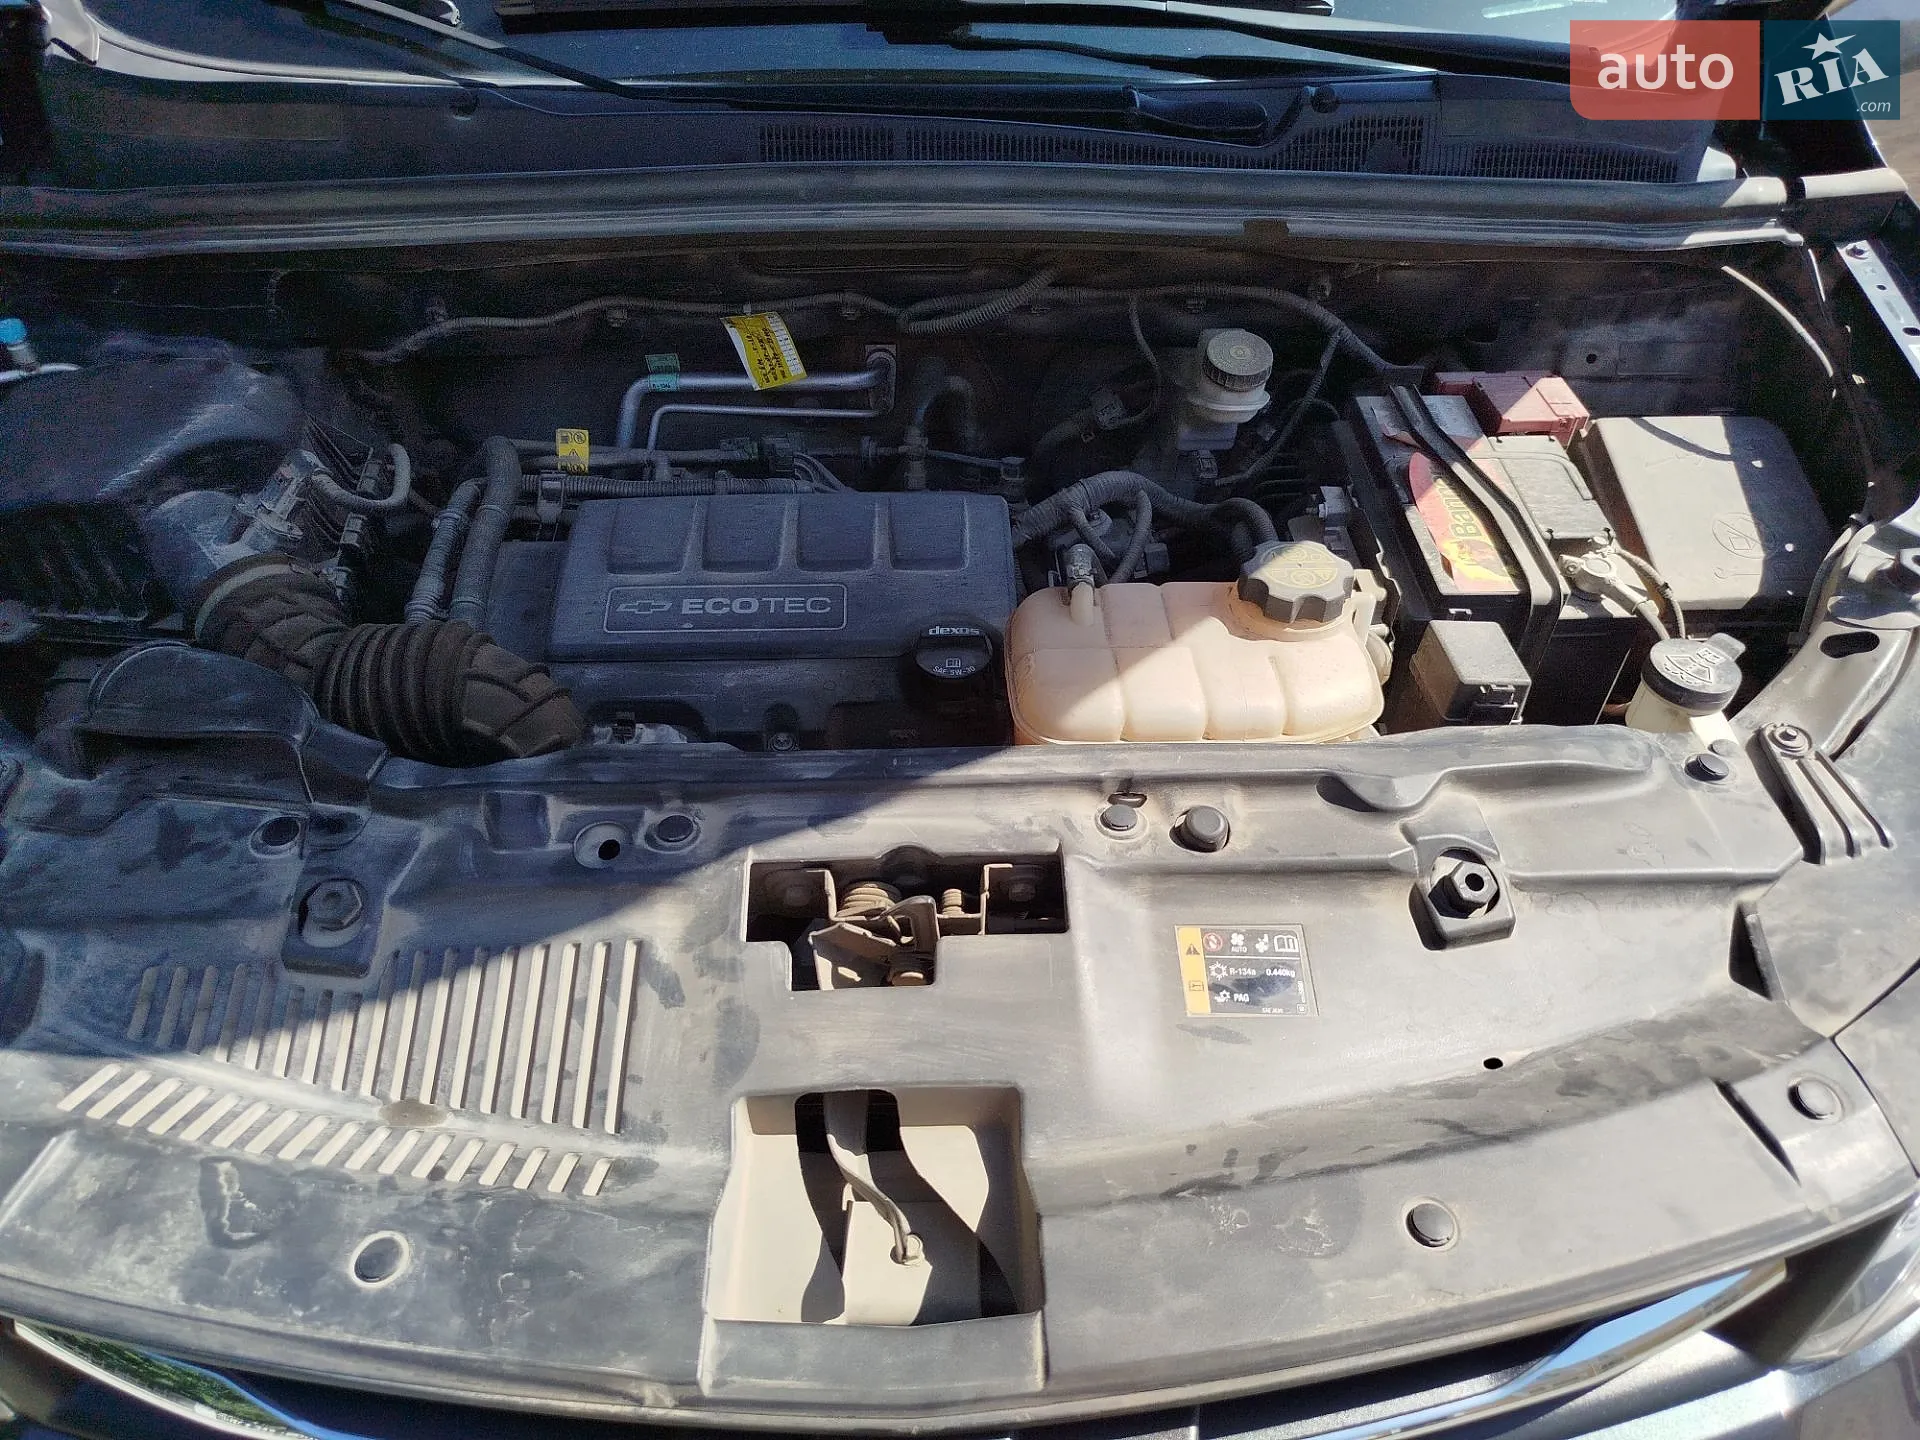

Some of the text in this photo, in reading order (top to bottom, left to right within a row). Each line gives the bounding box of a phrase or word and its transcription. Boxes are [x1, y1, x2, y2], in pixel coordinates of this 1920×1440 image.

[681, 597, 831, 615] ECOTEC
[928, 626, 980, 635] dexos
[1231, 945, 1248, 953] AUTO
[1229, 967, 1257, 976] R-134a
[1233, 993, 1250, 1002] PAG
